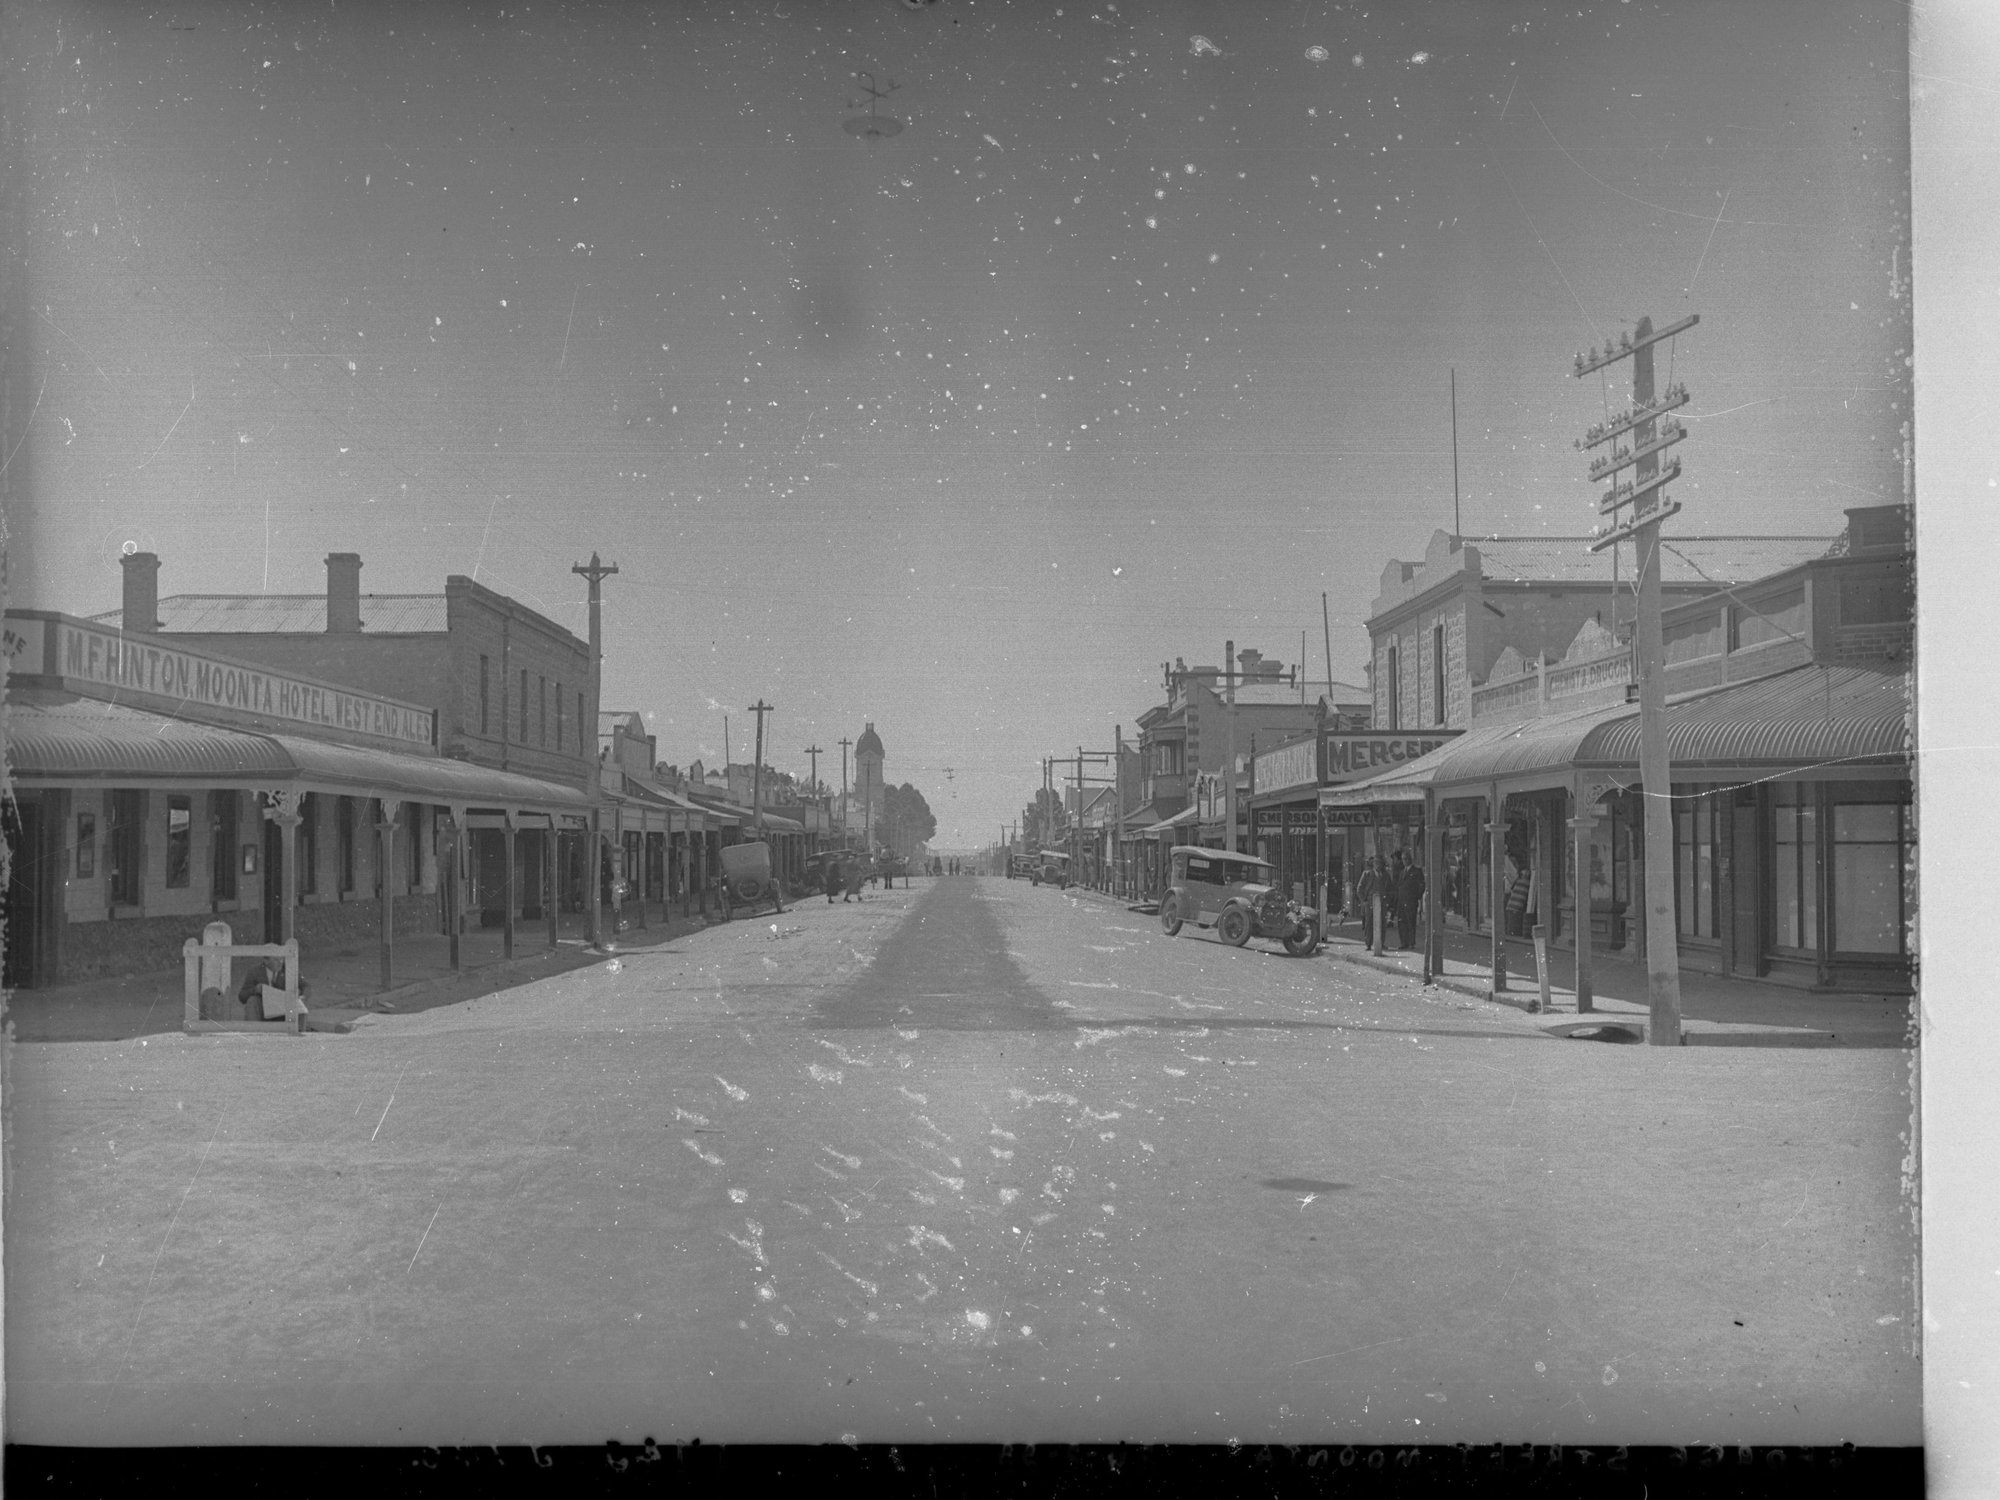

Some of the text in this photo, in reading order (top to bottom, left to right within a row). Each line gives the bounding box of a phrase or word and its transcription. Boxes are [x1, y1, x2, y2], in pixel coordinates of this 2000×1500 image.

[196, 661, 272, 713] MOONTA
[336, 694, 370, 731] WEST
[374, 703, 398, 736] END
[402, 711, 430, 741] ALES
